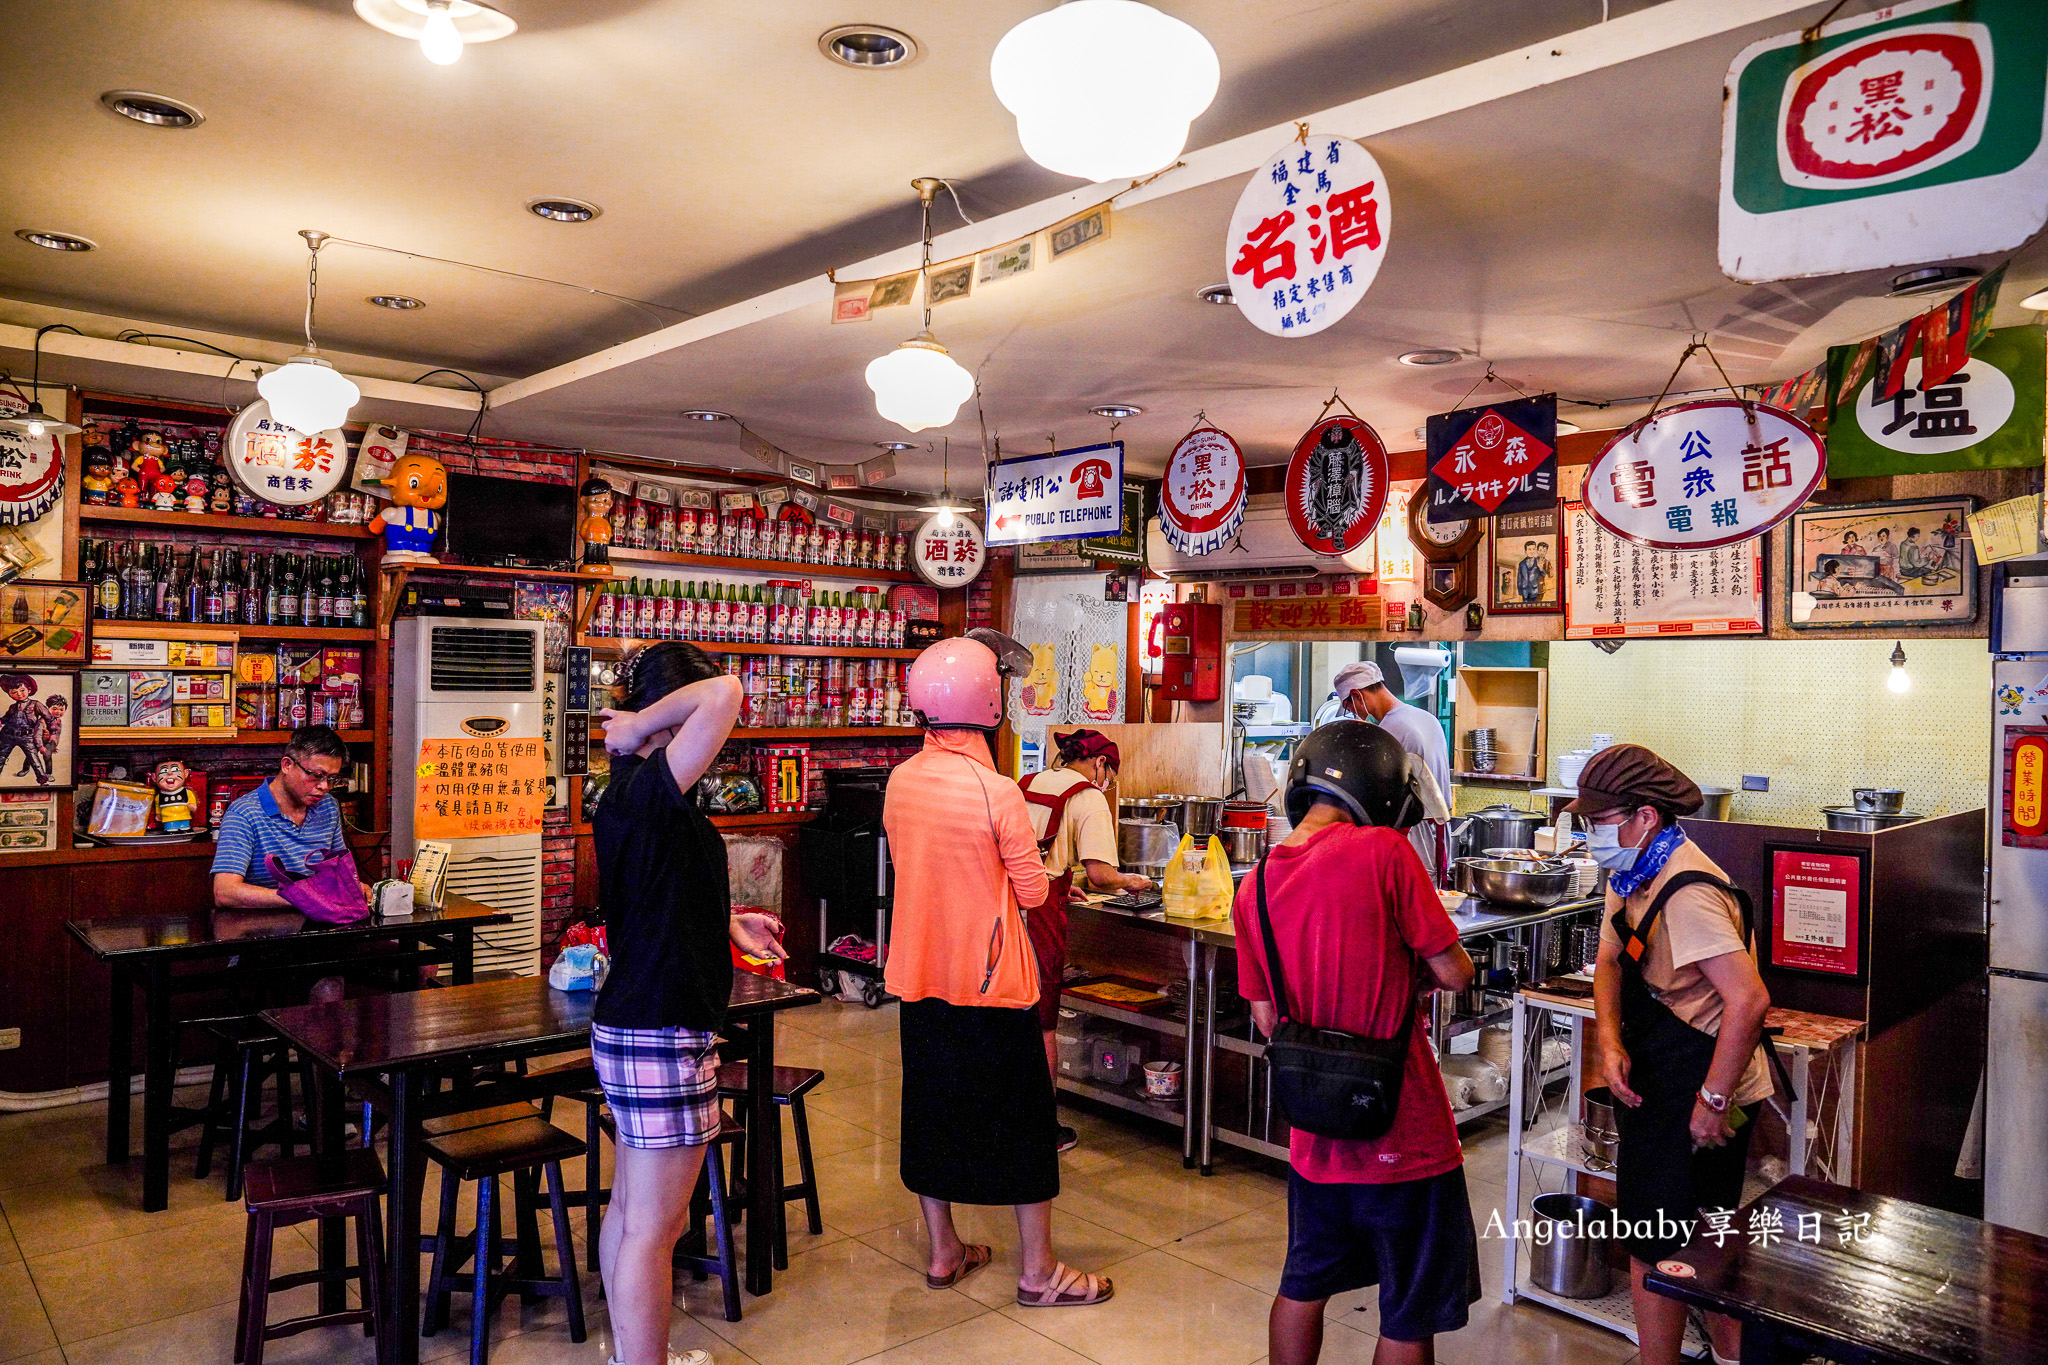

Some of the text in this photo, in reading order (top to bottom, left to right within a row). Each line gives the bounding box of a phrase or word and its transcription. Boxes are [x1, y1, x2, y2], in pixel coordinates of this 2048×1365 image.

[1845, 70, 1913, 145] 黑松
[1272, 141, 1342, 184] 福建省
[1283, 170, 1332, 206] 金馬
[1232, 181, 1382, 289] 名酒
[1272, 264, 1354, 311] 指定零售商
[1281, 307, 1311, 330] 編號
[1187, 452, 1216, 502] 黑松
[1025, 505, 1112, 526] PUBLIC TELEPHONE
[1190, 502, 1212, 512] DRINK
[1665, 498, 1740, 533] 電報
[1250, 598, 1368, 630] 歡迎光臨
[86, 708, 122, 716] DETERGENT
[543, 680, 556, 743] 安全衛生
[437, 741, 537, 759] 本店肉品皆使用
[2018, 751, 2037, 822] 營業時間
[434, 799, 509, 817] 餐具請自取
